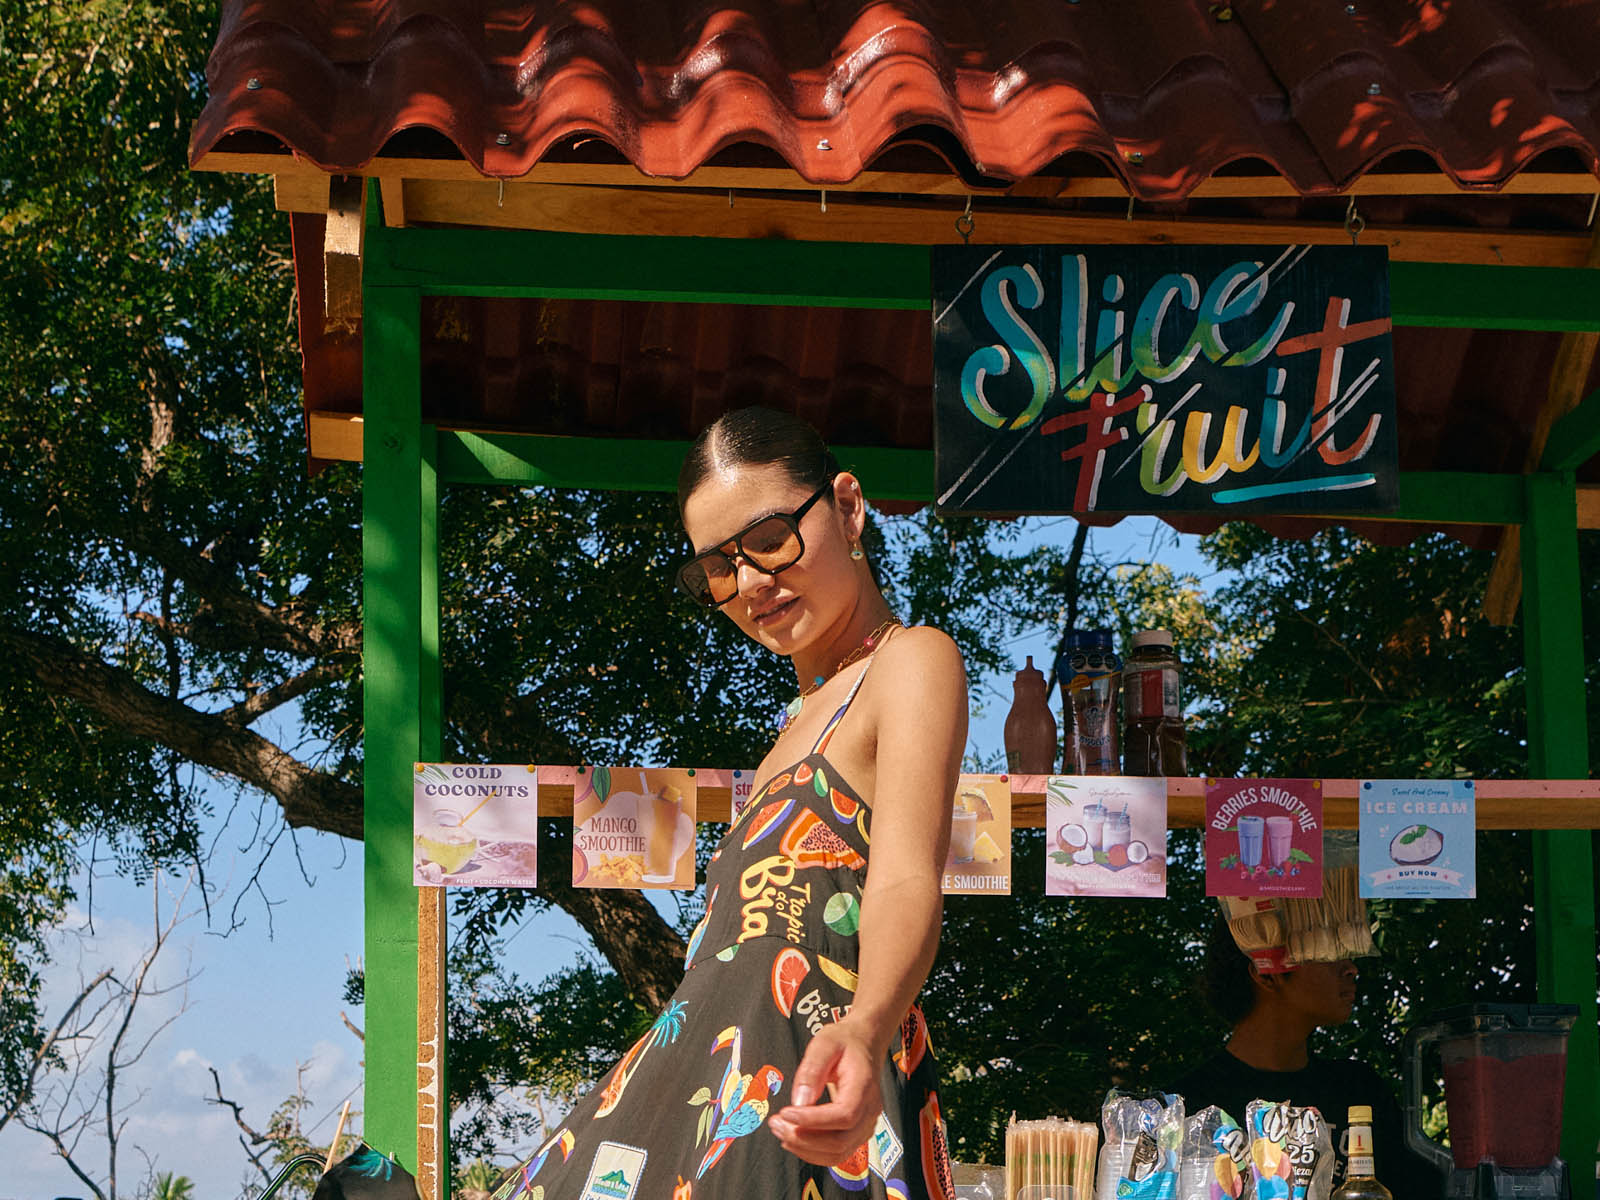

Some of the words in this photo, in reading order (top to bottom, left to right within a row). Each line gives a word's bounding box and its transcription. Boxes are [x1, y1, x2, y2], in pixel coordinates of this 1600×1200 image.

[960, 252, 1295, 431] Slice
[1040, 295, 1392, 512] Fruit
[451, 766, 503, 779] COLD
[424, 783, 529, 798] COCONUTS
[1211, 787, 1258, 831] BERRIES
[1260, 785, 1318, 833] SMOOTHIE
[1367, 801, 1398, 815] ICE
[1402, 801, 1468, 815] CREAM
[591, 817, 637, 833] MANGO
[580, 835, 647, 852] SMOOTHIE
[1399, 870, 1415, 878] BUY
[1417, 870, 1438, 878] NOW
[953, 875, 1009, 890] SMOOTHIE
[1287, 1143, 1315, 1165] 25
